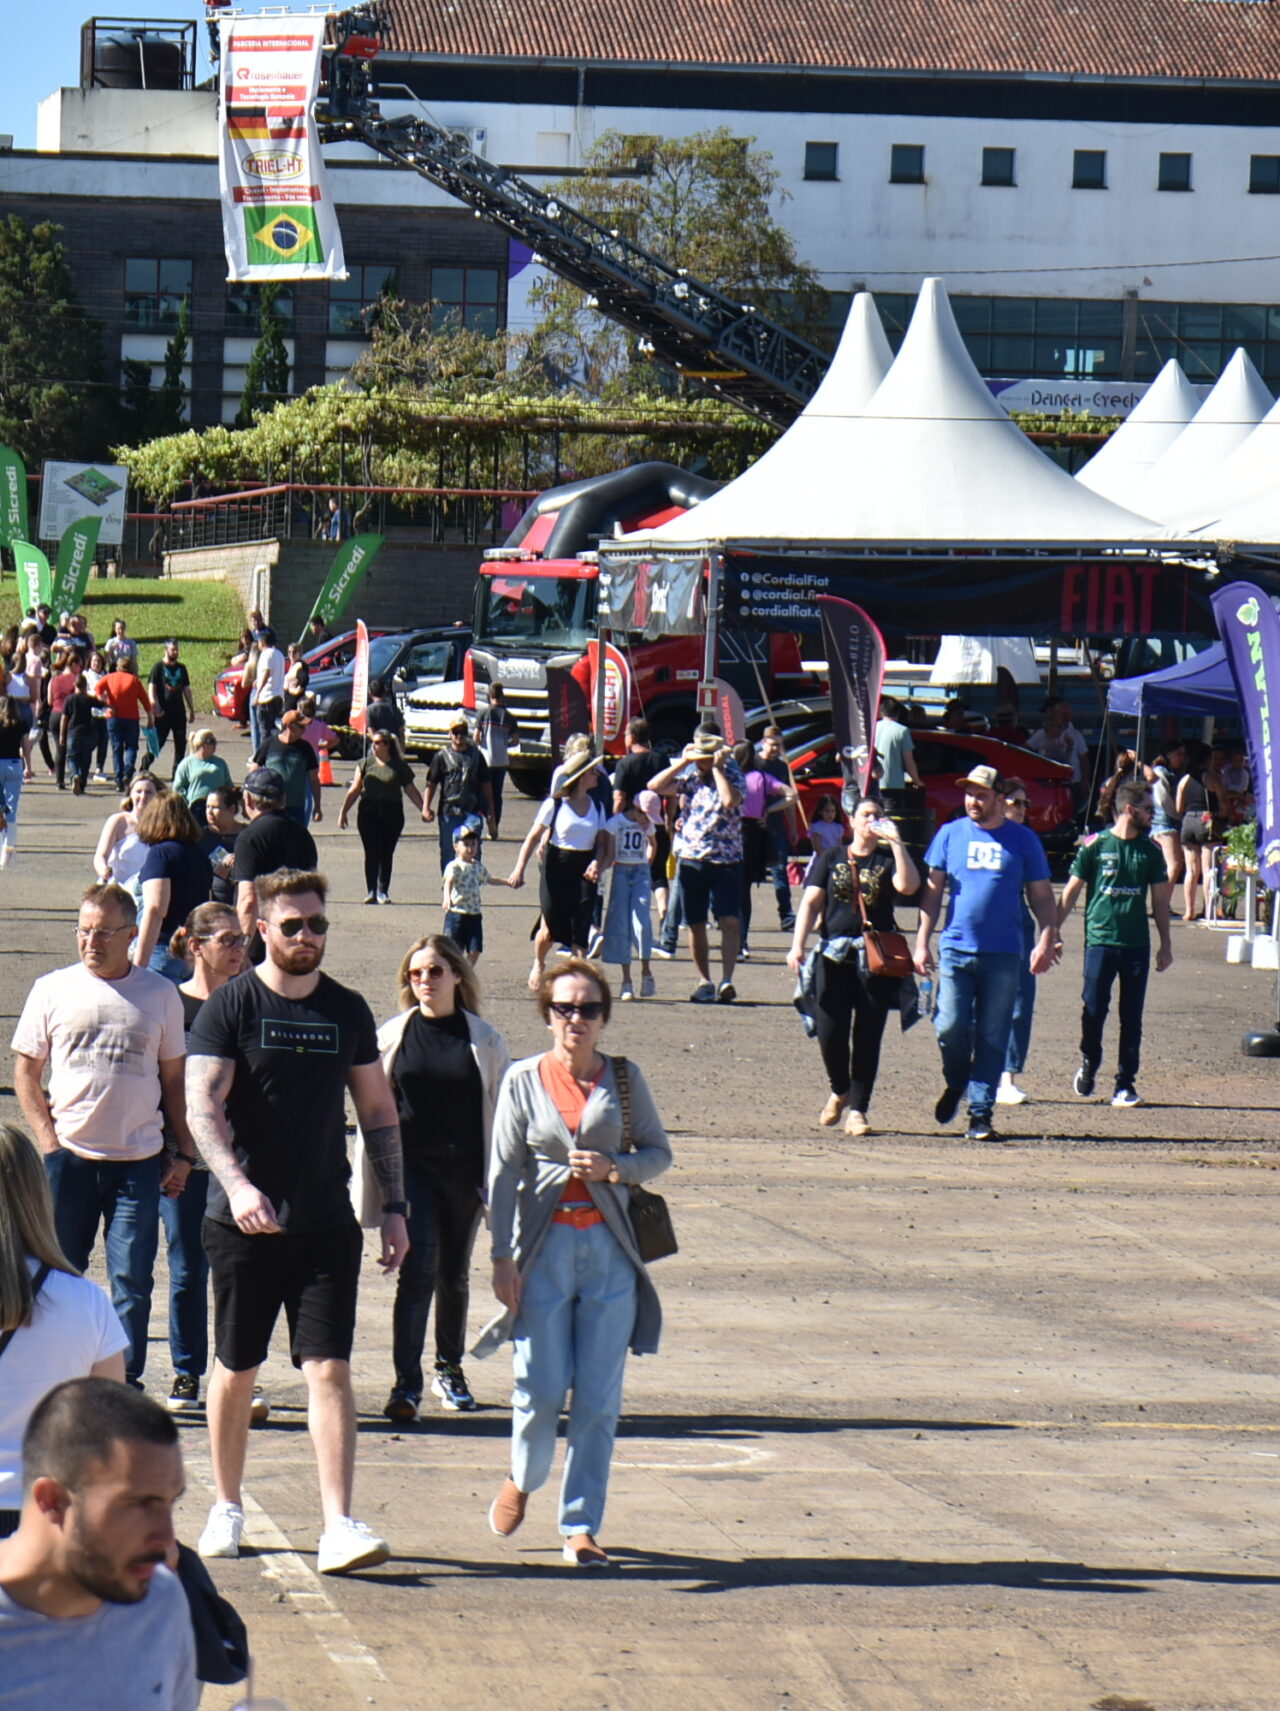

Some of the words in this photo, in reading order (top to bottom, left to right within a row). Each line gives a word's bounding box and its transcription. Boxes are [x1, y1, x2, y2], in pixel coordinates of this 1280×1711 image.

[262, 39, 309, 47] INTERNACIONAL
[246, 159, 303, 173] TRIEL-HT
[5, 465, 20, 525] Sicredi
[62, 531, 88, 594] Sicredi
[328, 544, 366, 604] Sicredi
[751, 571, 830, 586] @CordialFiat
[1061, 565, 1161, 633] FIAT
[720, 694, 736, 747] CORDIAL
[623, 831, 642, 850] 10
[966, 841, 1003, 870] DC
[270, 1030, 331, 1041] BILLABONG
